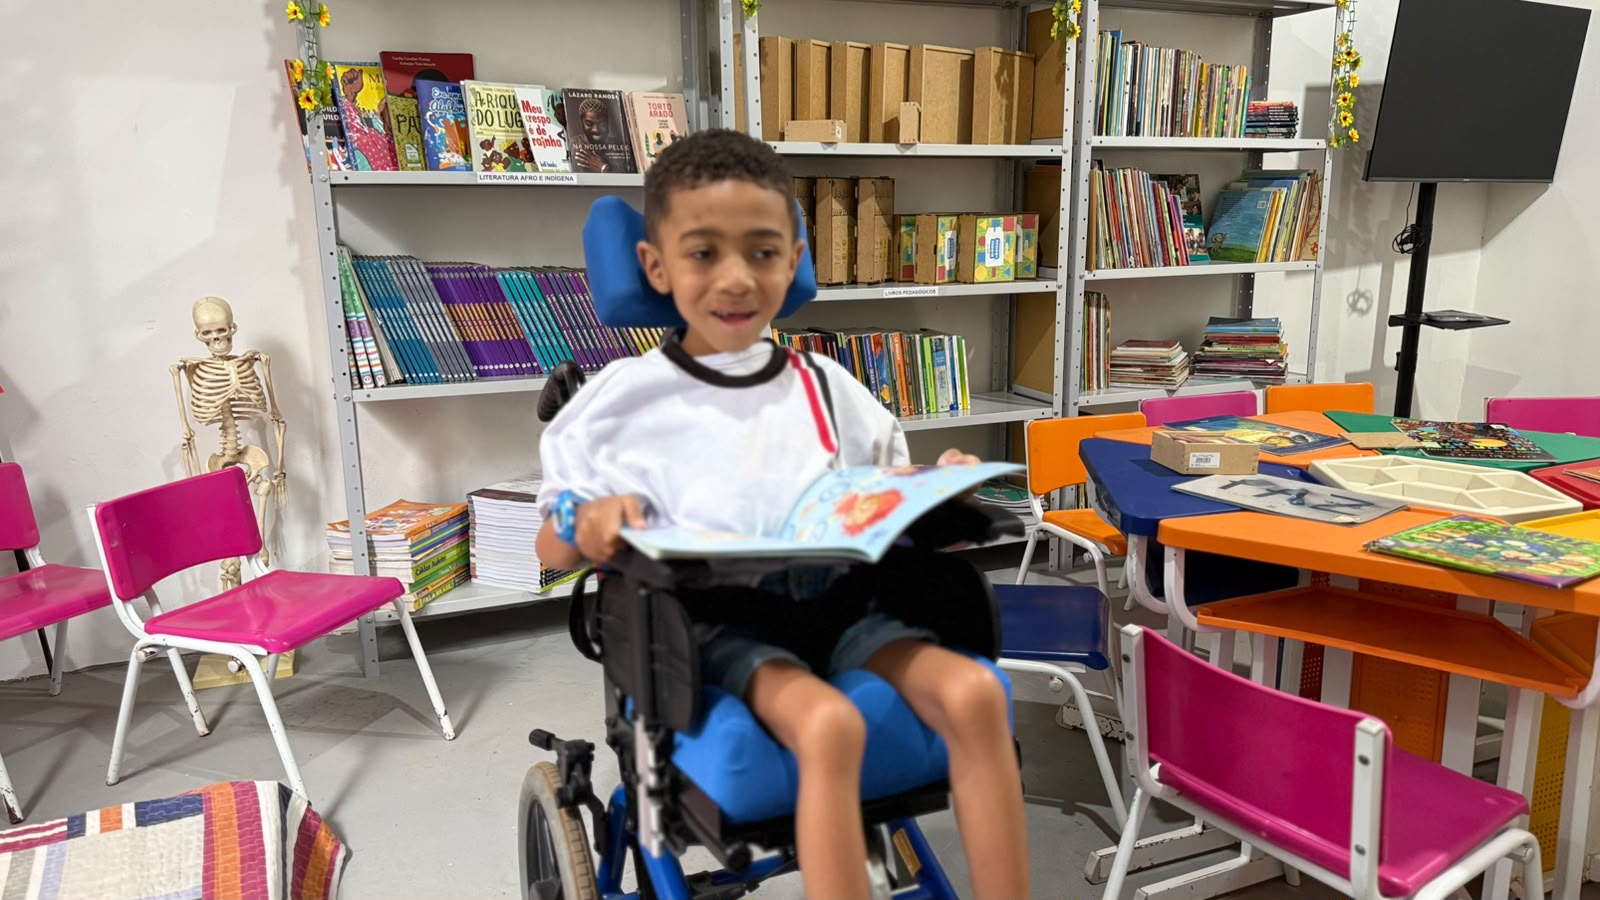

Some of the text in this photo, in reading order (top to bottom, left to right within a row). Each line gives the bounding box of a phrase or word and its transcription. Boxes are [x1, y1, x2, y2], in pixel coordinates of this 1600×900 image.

[368, 74, 384, 83] M
[475, 91, 520, 111] A RIQU
[568, 91, 593, 99] LÁZARO
[520, 100, 543, 115] Meu
[647, 102, 673, 111] TORTO
[476, 109, 494, 128] DO
[649, 110, 674, 118] ARADO
[395, 113, 421, 133] PA
[525, 114, 552, 127] crespo
[528, 124, 535, 135] é
[536, 124, 547, 136] de
[532, 134, 563, 149] rainha
[544, 174, 574, 182] INDÍGENA
